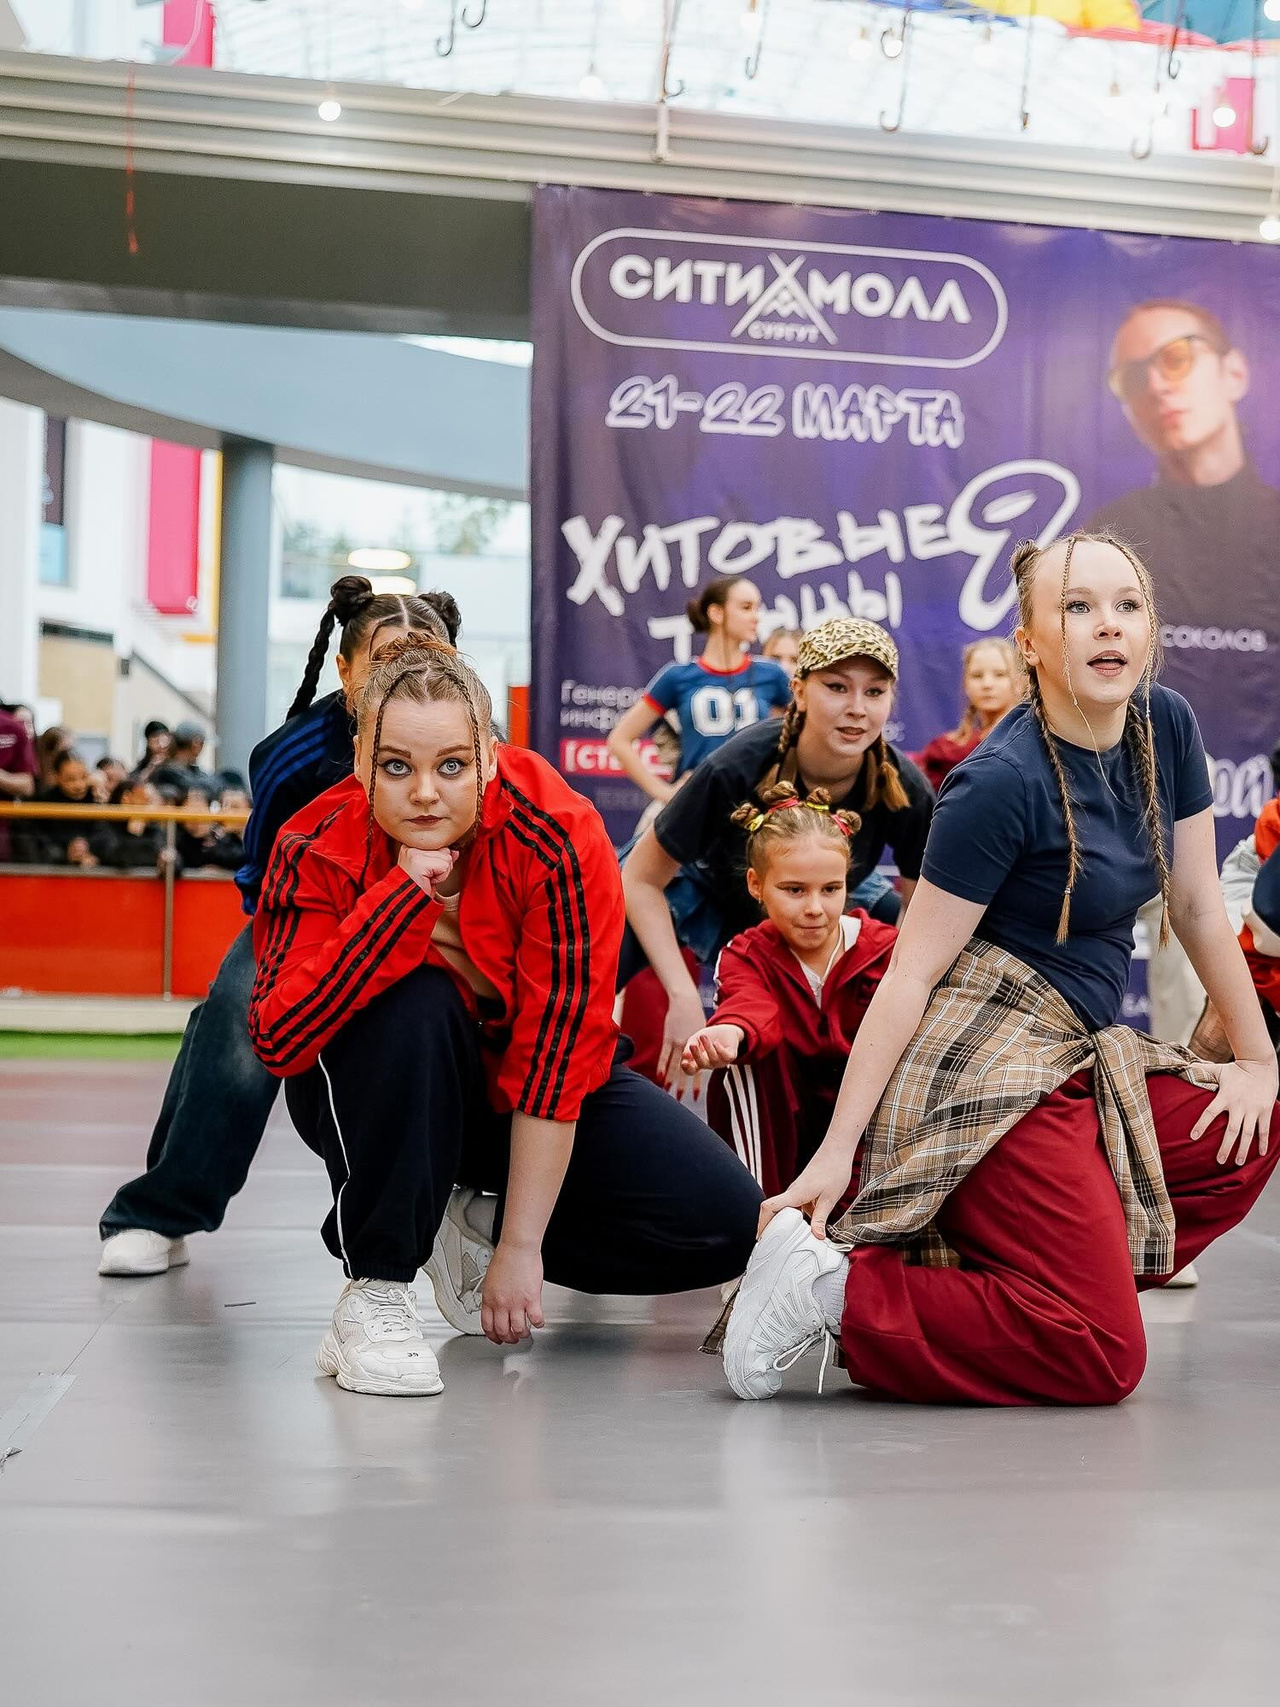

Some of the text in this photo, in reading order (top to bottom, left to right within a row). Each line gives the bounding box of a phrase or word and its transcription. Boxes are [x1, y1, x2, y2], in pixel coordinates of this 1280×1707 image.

[608, 253, 972, 324] СИТИ МОЛЛ
[605, 375, 965, 449] 21-22 МАРТА
[691, 685, 760, 737] 01
